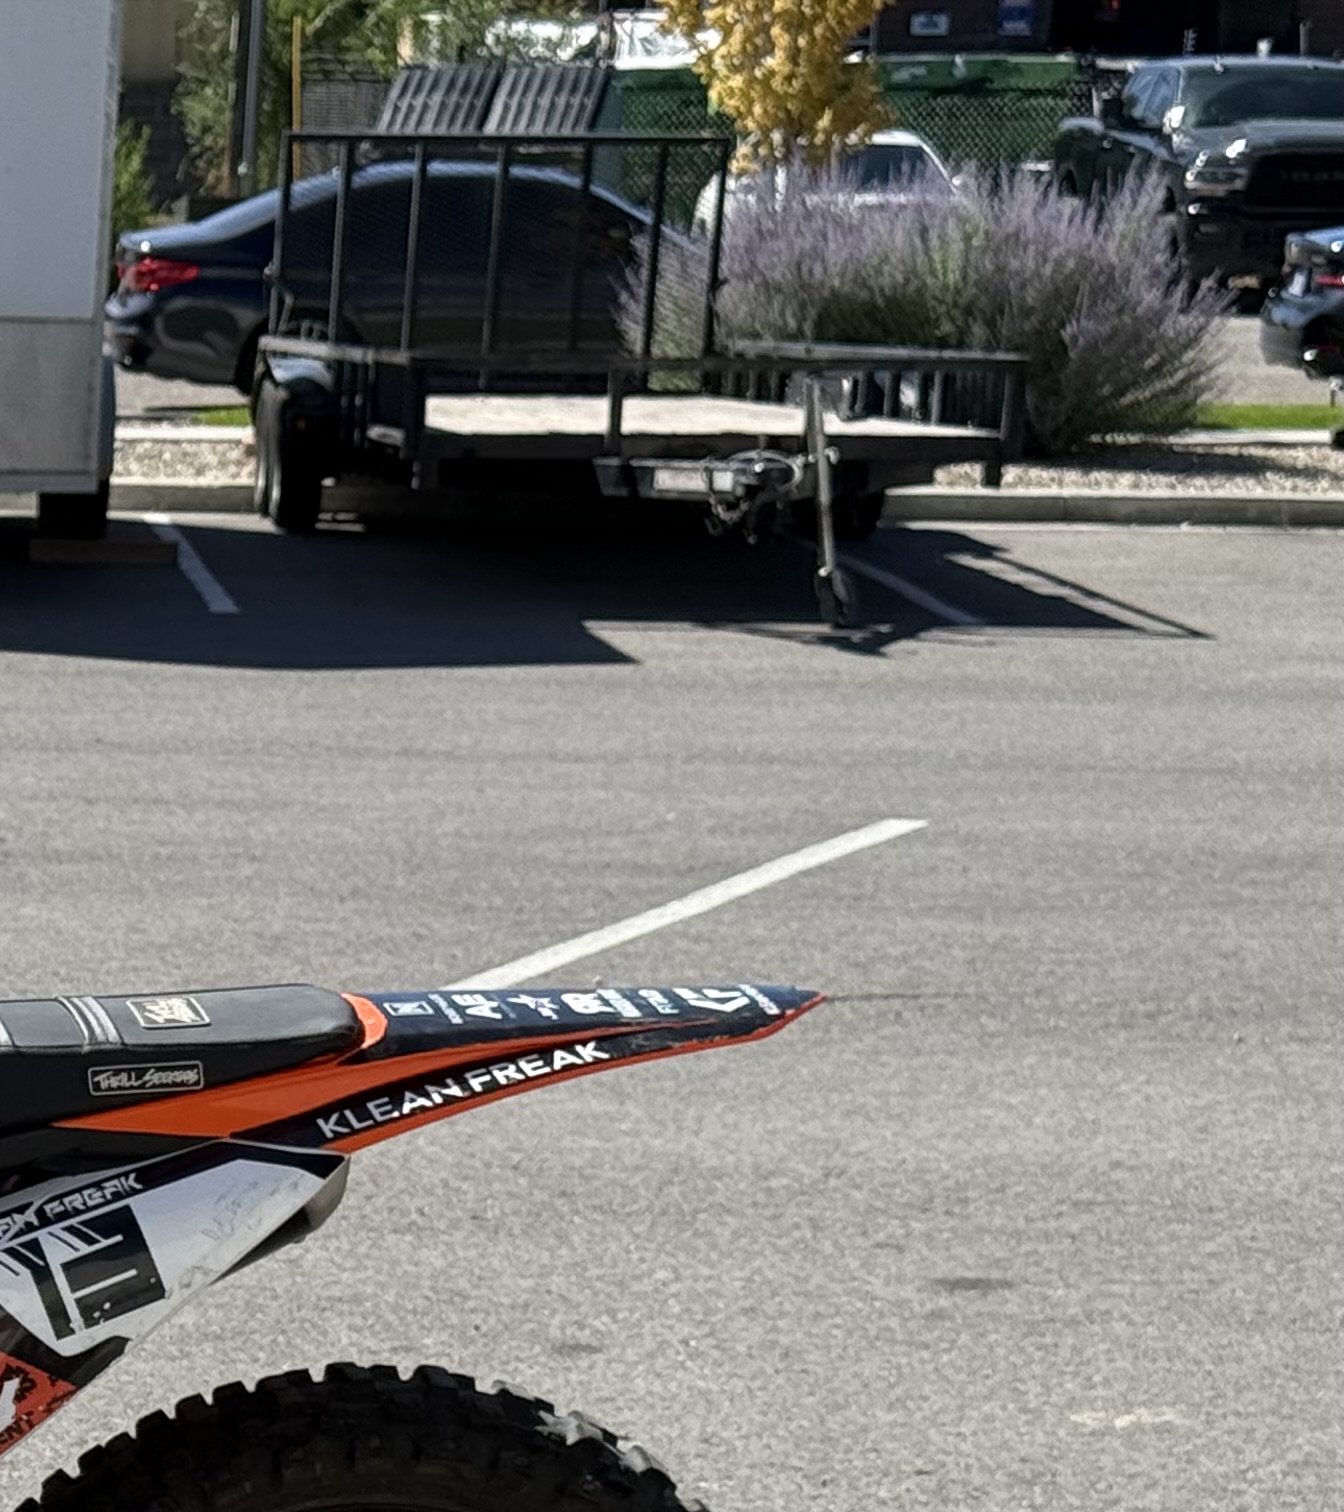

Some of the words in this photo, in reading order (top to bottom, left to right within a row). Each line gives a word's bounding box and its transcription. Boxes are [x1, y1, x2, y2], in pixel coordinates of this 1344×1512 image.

[316, 1078, 464, 1139] KLEAN
[465, 1041, 610, 1092] FREAK
[43, 1172, 143, 1220] FREAK
